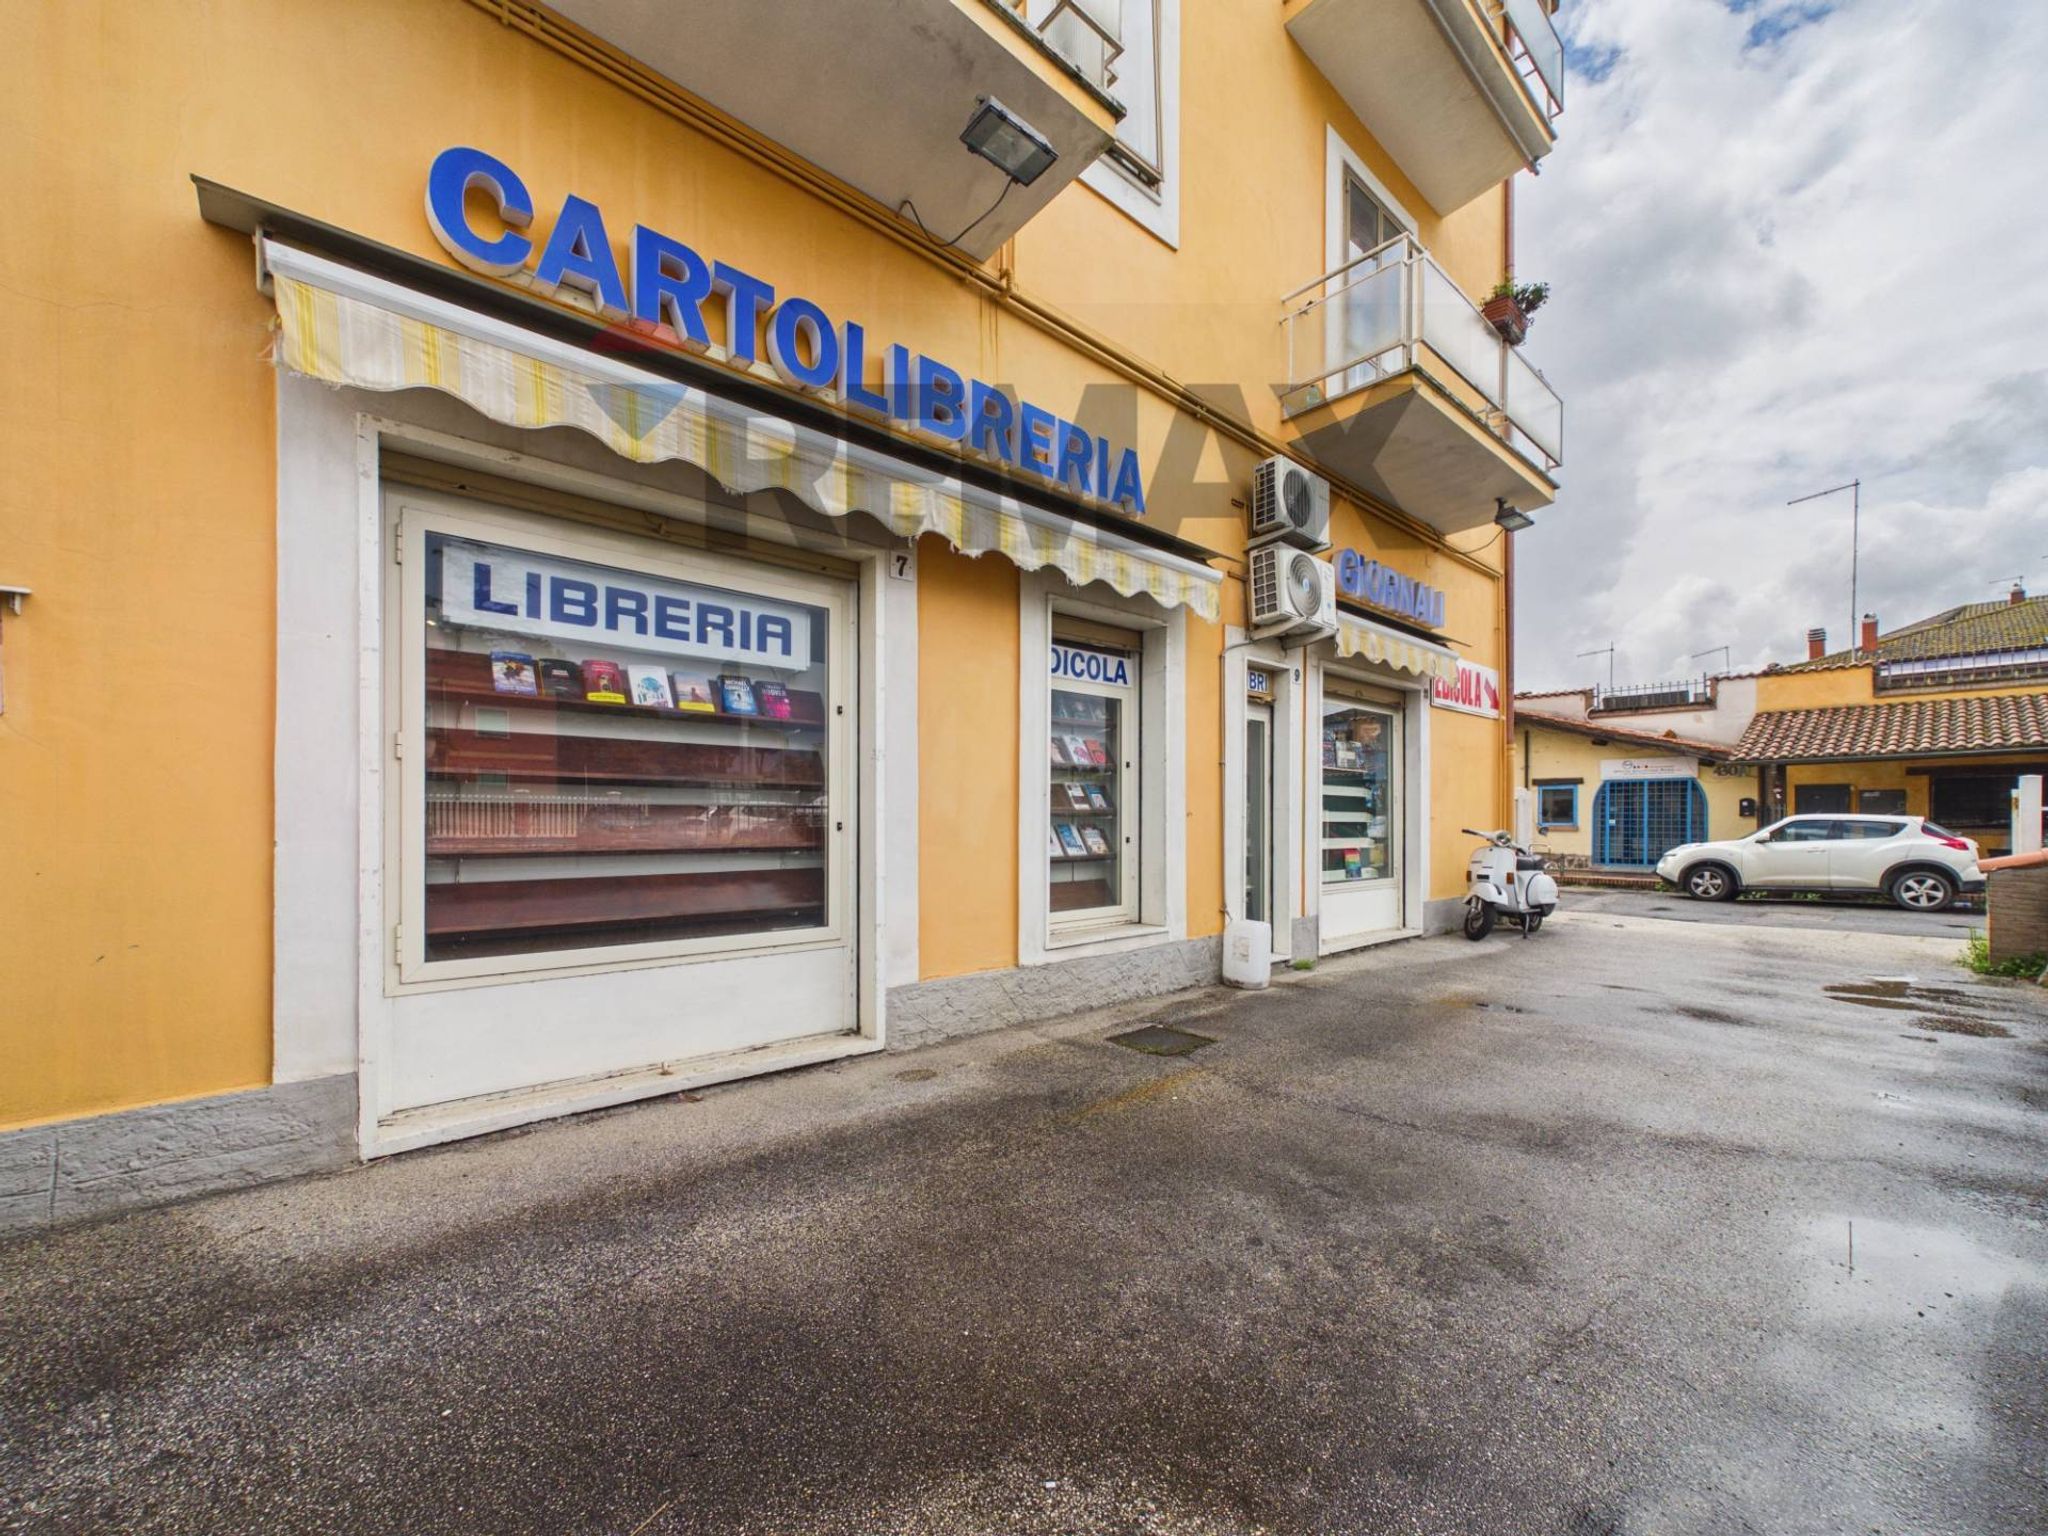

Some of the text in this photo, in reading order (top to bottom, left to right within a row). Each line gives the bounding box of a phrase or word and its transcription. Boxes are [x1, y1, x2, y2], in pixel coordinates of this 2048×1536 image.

[425, 146, 1146, 518] CARTOLIBRERIA
[896, 555, 908, 577] 7
[1333, 548, 1445, 628] GIORNALI
[473, 562, 792, 657] LIBRERIA
[1294, 668, 1300, 682] 9
